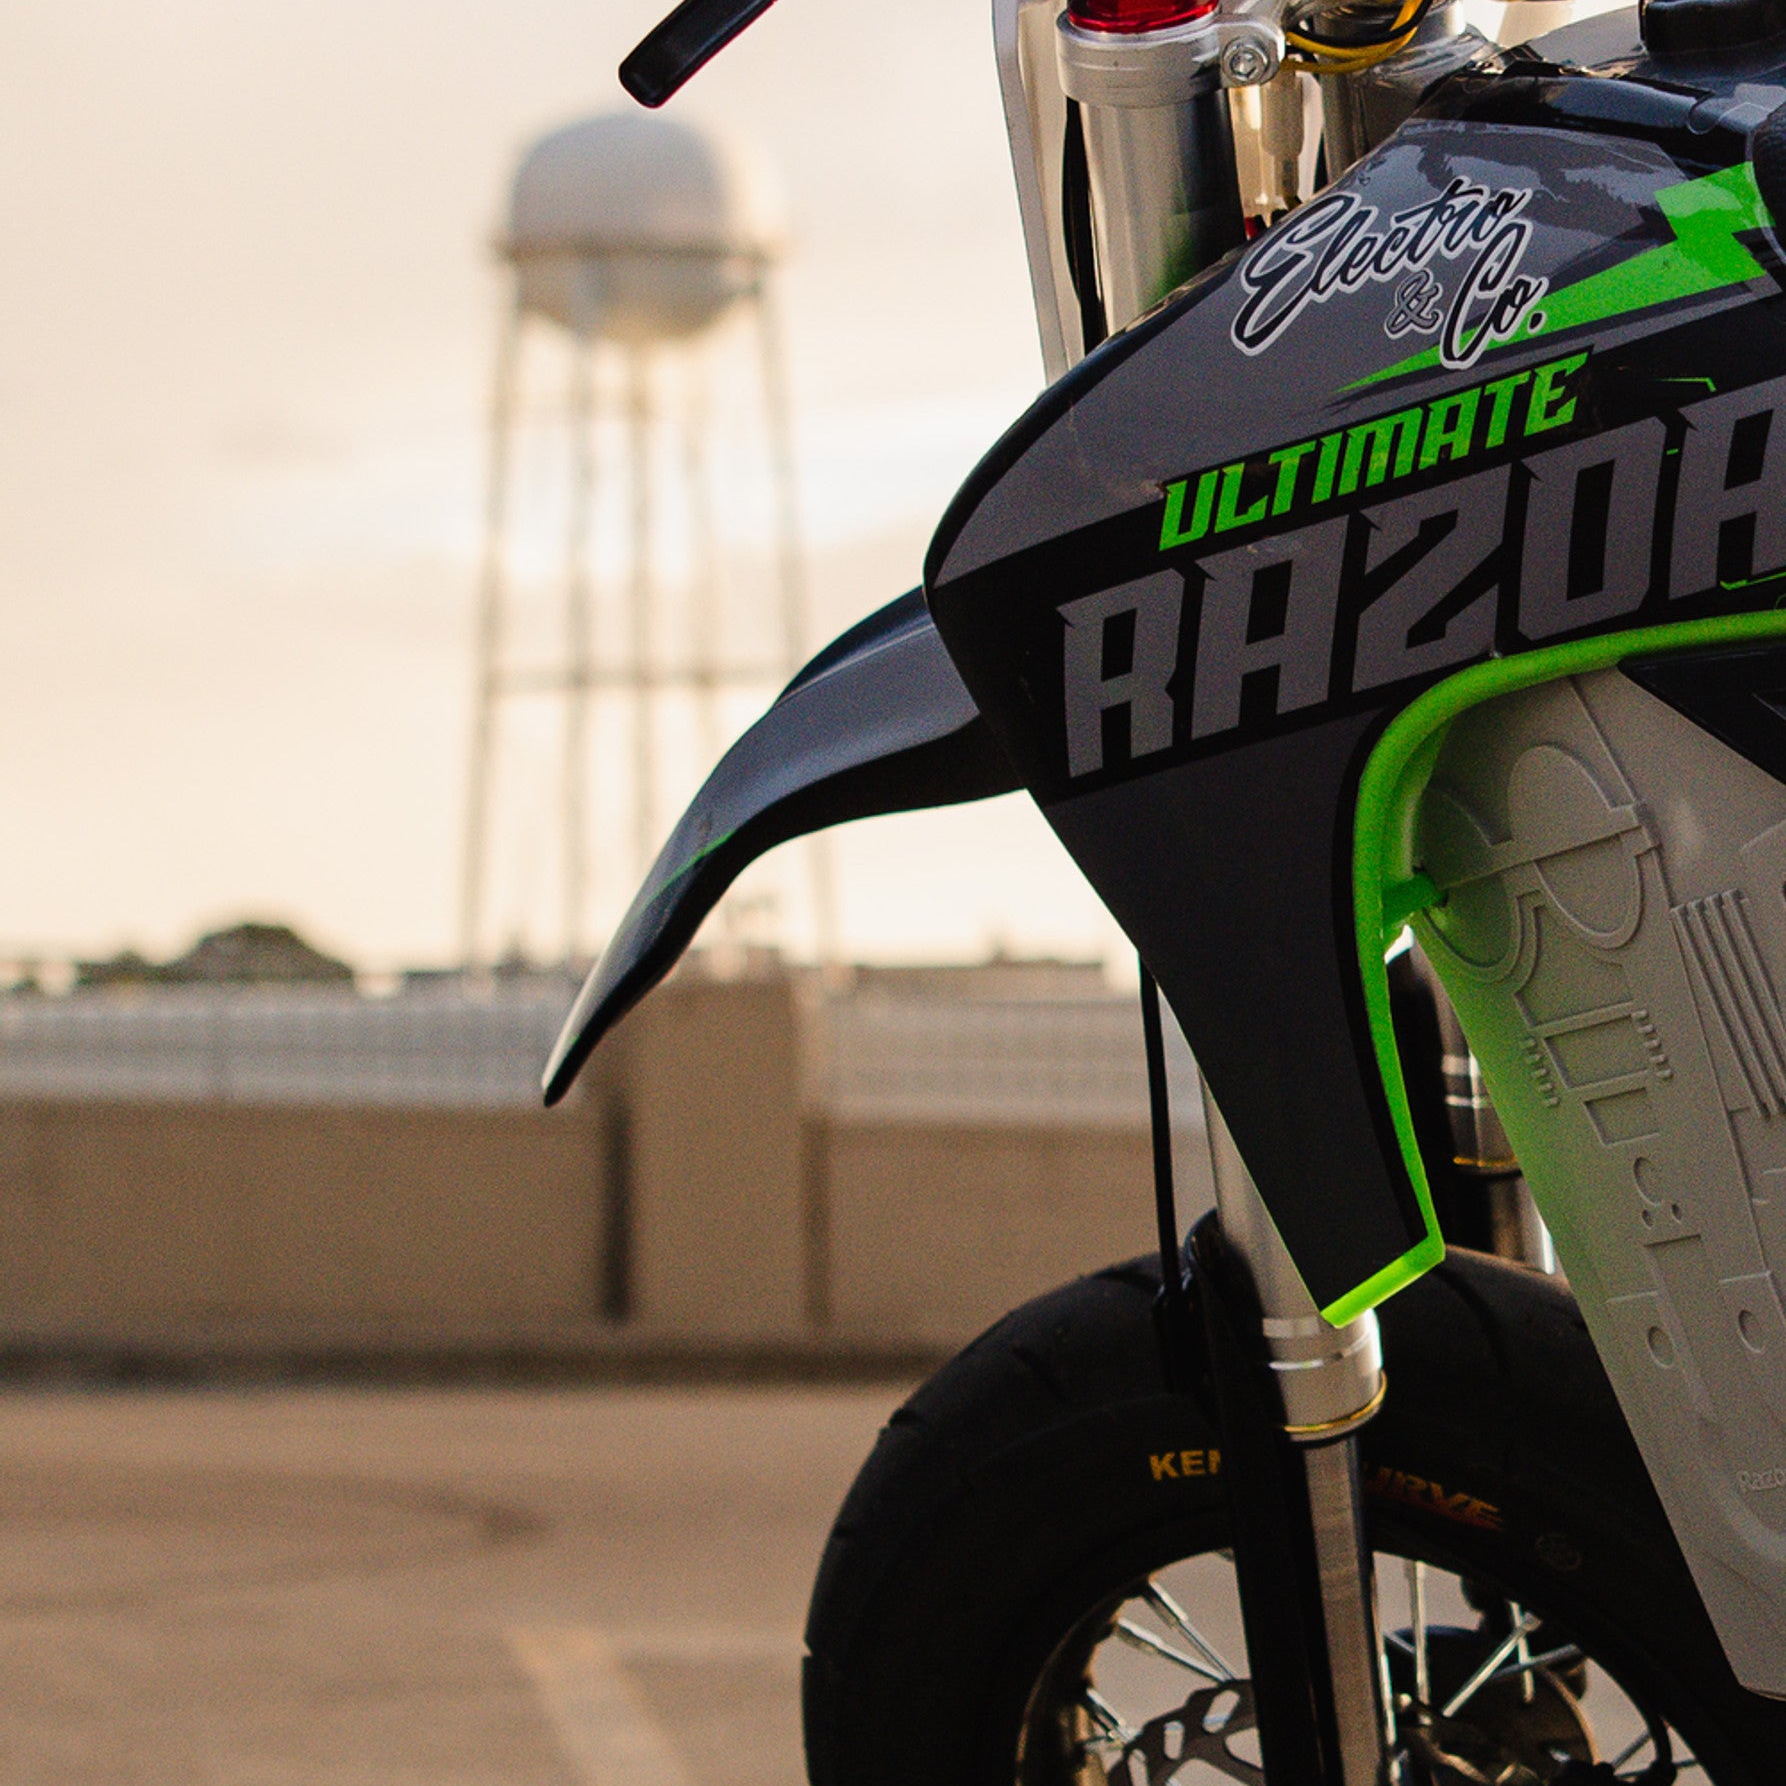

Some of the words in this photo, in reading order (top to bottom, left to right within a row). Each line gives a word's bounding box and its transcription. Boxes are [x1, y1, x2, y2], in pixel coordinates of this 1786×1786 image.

[1231, 175, 1533, 356] Electro
[1384, 266, 1443, 339] &
[1439, 218, 1549, 370] Co.
[1159, 350, 1593, 552] ULTIMATE
